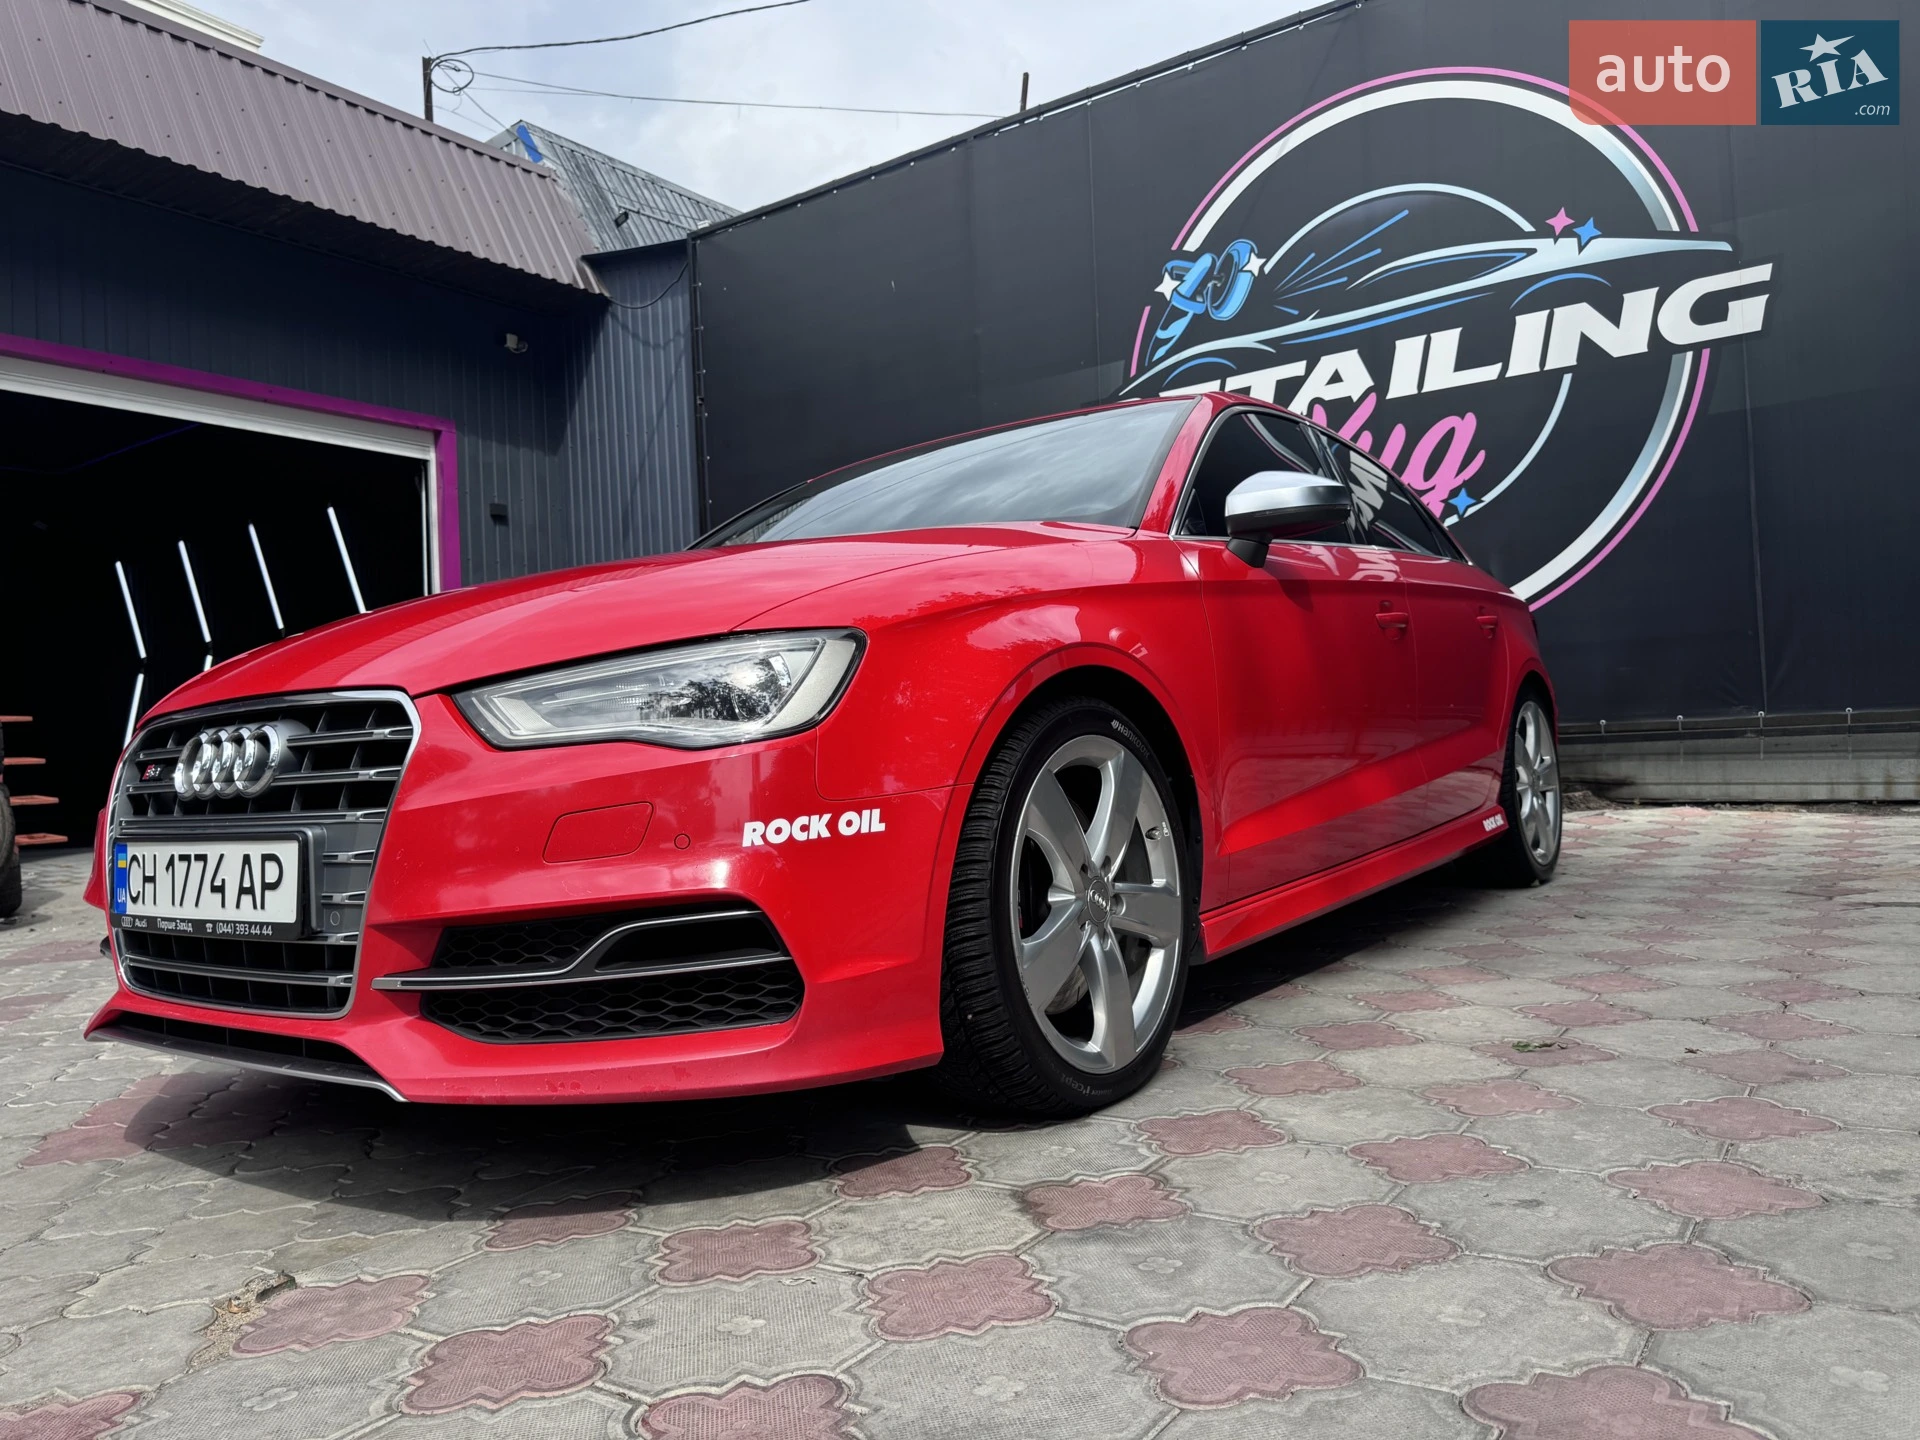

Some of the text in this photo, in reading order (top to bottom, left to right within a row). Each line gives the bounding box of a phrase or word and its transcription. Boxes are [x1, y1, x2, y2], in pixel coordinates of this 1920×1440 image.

[1118, 263, 1773, 416] TAILING
[742, 808, 886, 847] ROCK OIL
[128, 853, 284, 910] CH 1774 AP
[117, 888, 126, 903] UA
[135, 919, 147, 928] Audi
[216, 922, 273, 936] (044) 393 44 44
